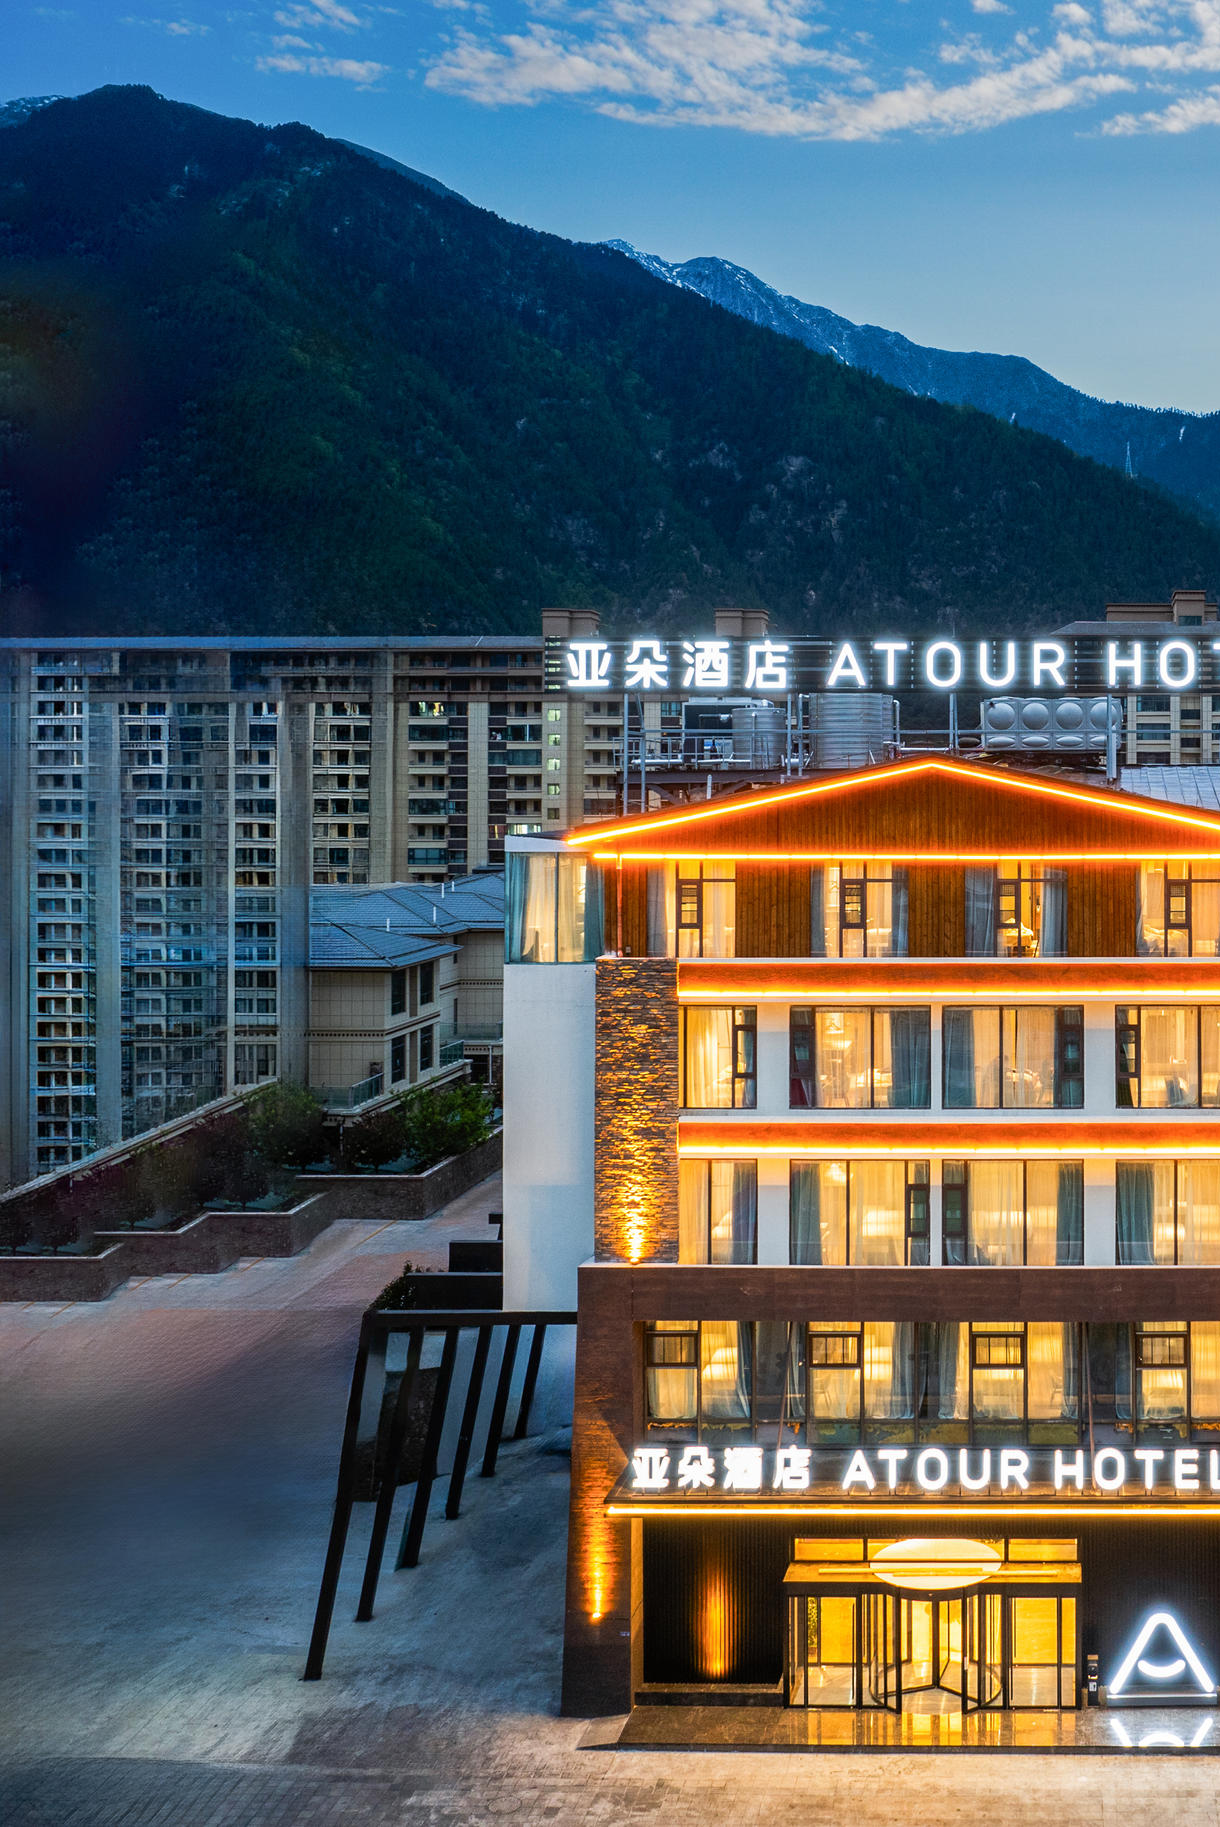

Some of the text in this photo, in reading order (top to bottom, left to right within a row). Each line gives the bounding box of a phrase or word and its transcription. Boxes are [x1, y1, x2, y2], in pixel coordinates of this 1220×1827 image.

[566, 640, 789, 689] 亚朵酒店
[827, 641, 1065, 688] ATOUR
[631, 1445, 812, 1490] 亚朵酒店
[842, 1448, 1029, 1491] ATOUR
